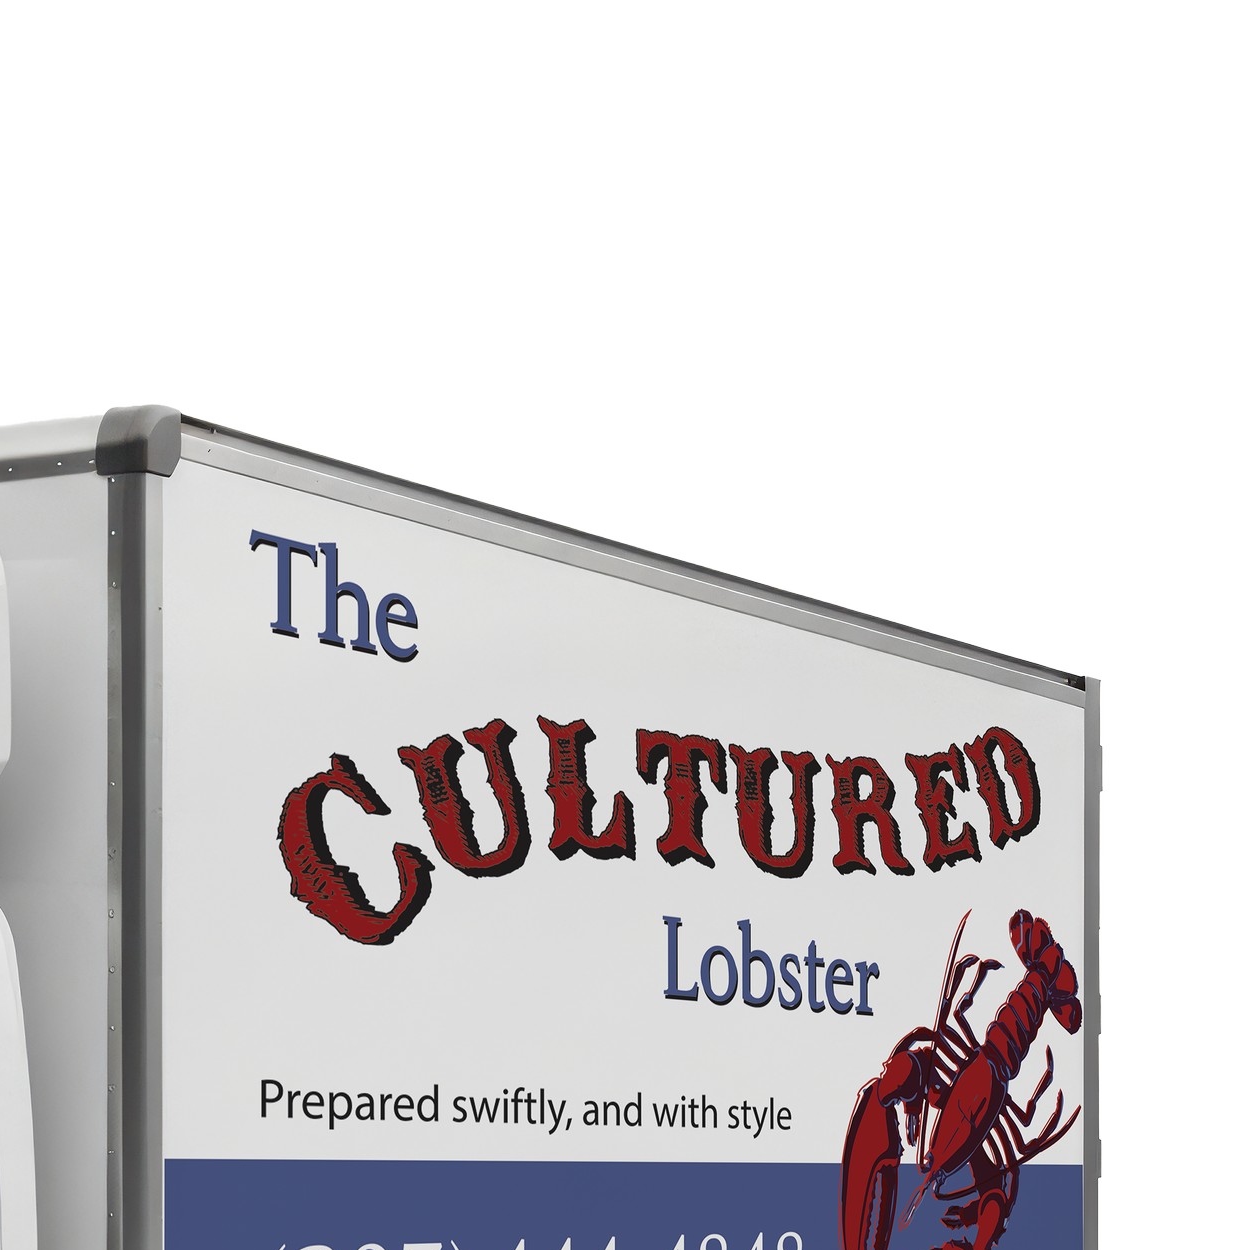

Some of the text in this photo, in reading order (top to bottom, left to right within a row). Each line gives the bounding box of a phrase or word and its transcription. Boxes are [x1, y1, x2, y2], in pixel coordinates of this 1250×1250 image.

[248, 528, 419, 663] The
[276, 714, 1042, 947] CULTURED
[662, 915, 881, 1017] Lobster
[260, 1078, 793, 1140] Prepared swiftly, and with style
